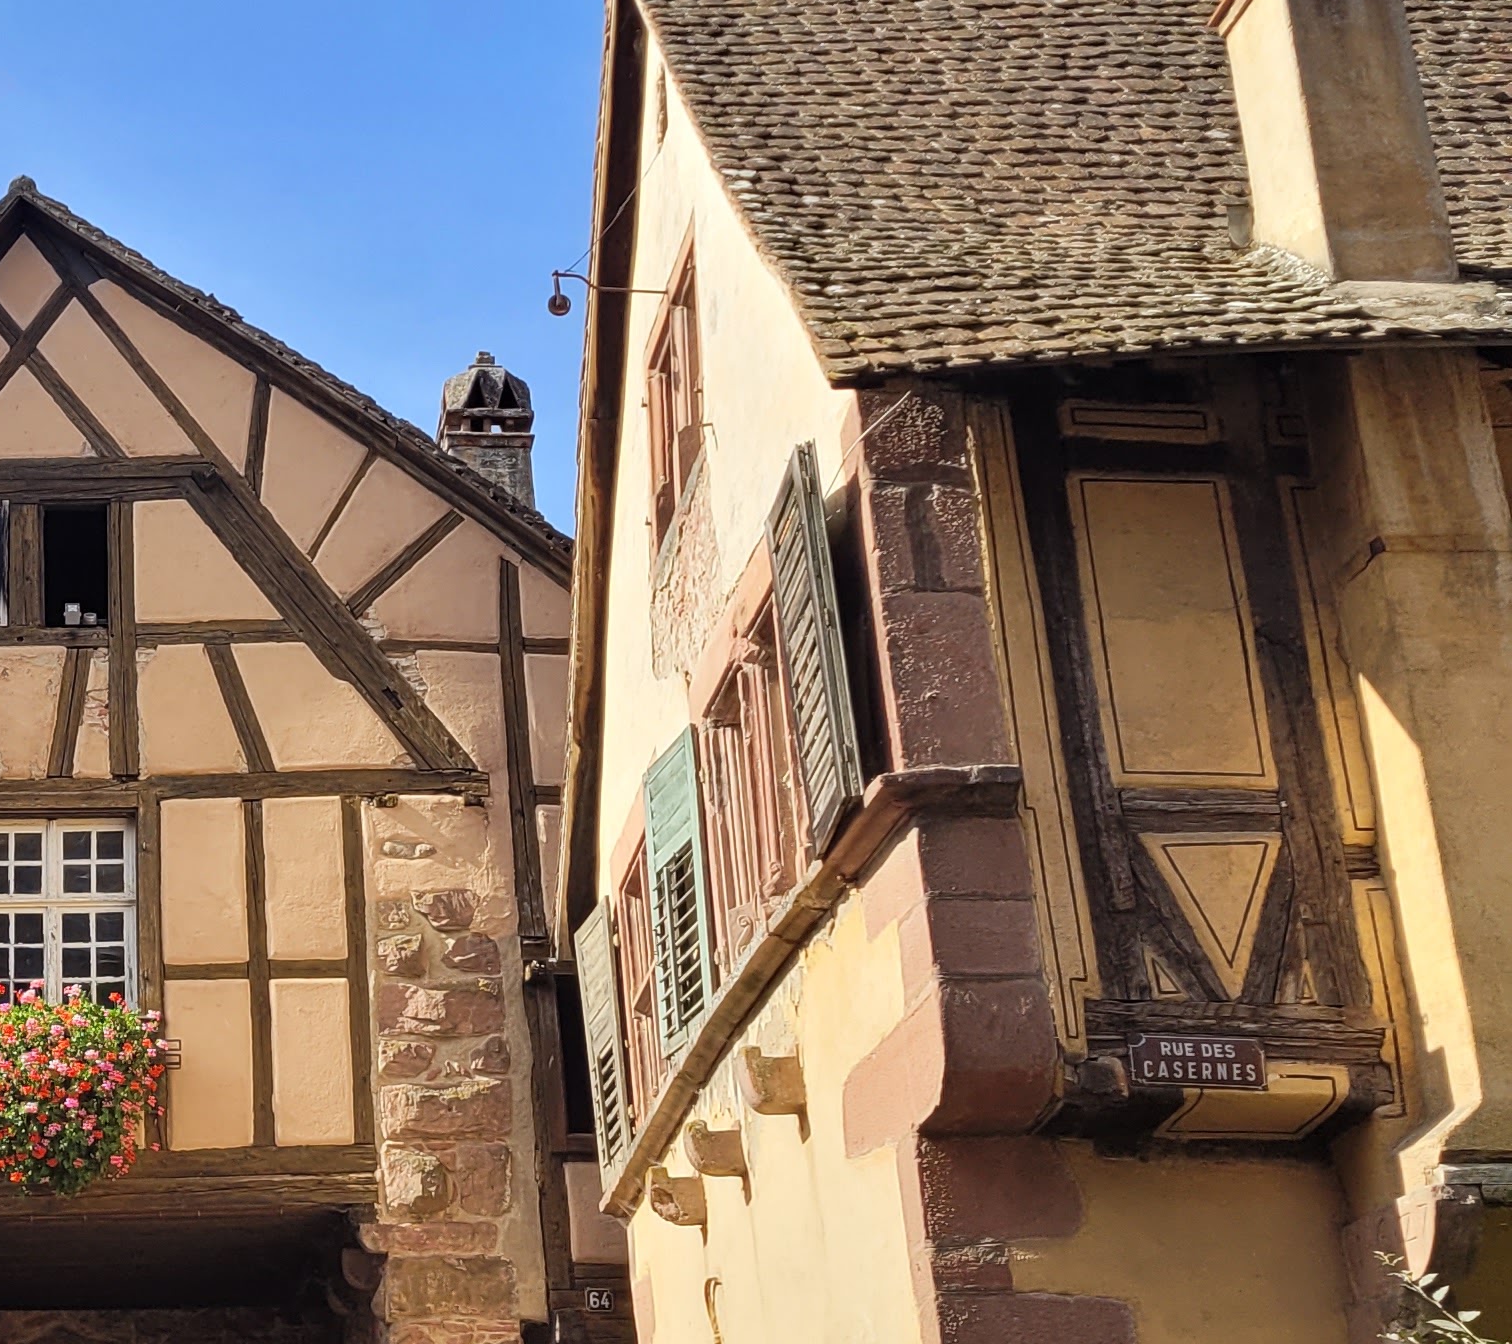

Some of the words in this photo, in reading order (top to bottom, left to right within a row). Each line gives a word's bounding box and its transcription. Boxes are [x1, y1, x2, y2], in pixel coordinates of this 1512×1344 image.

[1159, 1041, 1196, 1057] RUE
[1201, 1043, 1236, 1058] DES
[1143, 1060, 1257, 1082] CASERNES
[589, 1291, 610, 1309] 64
